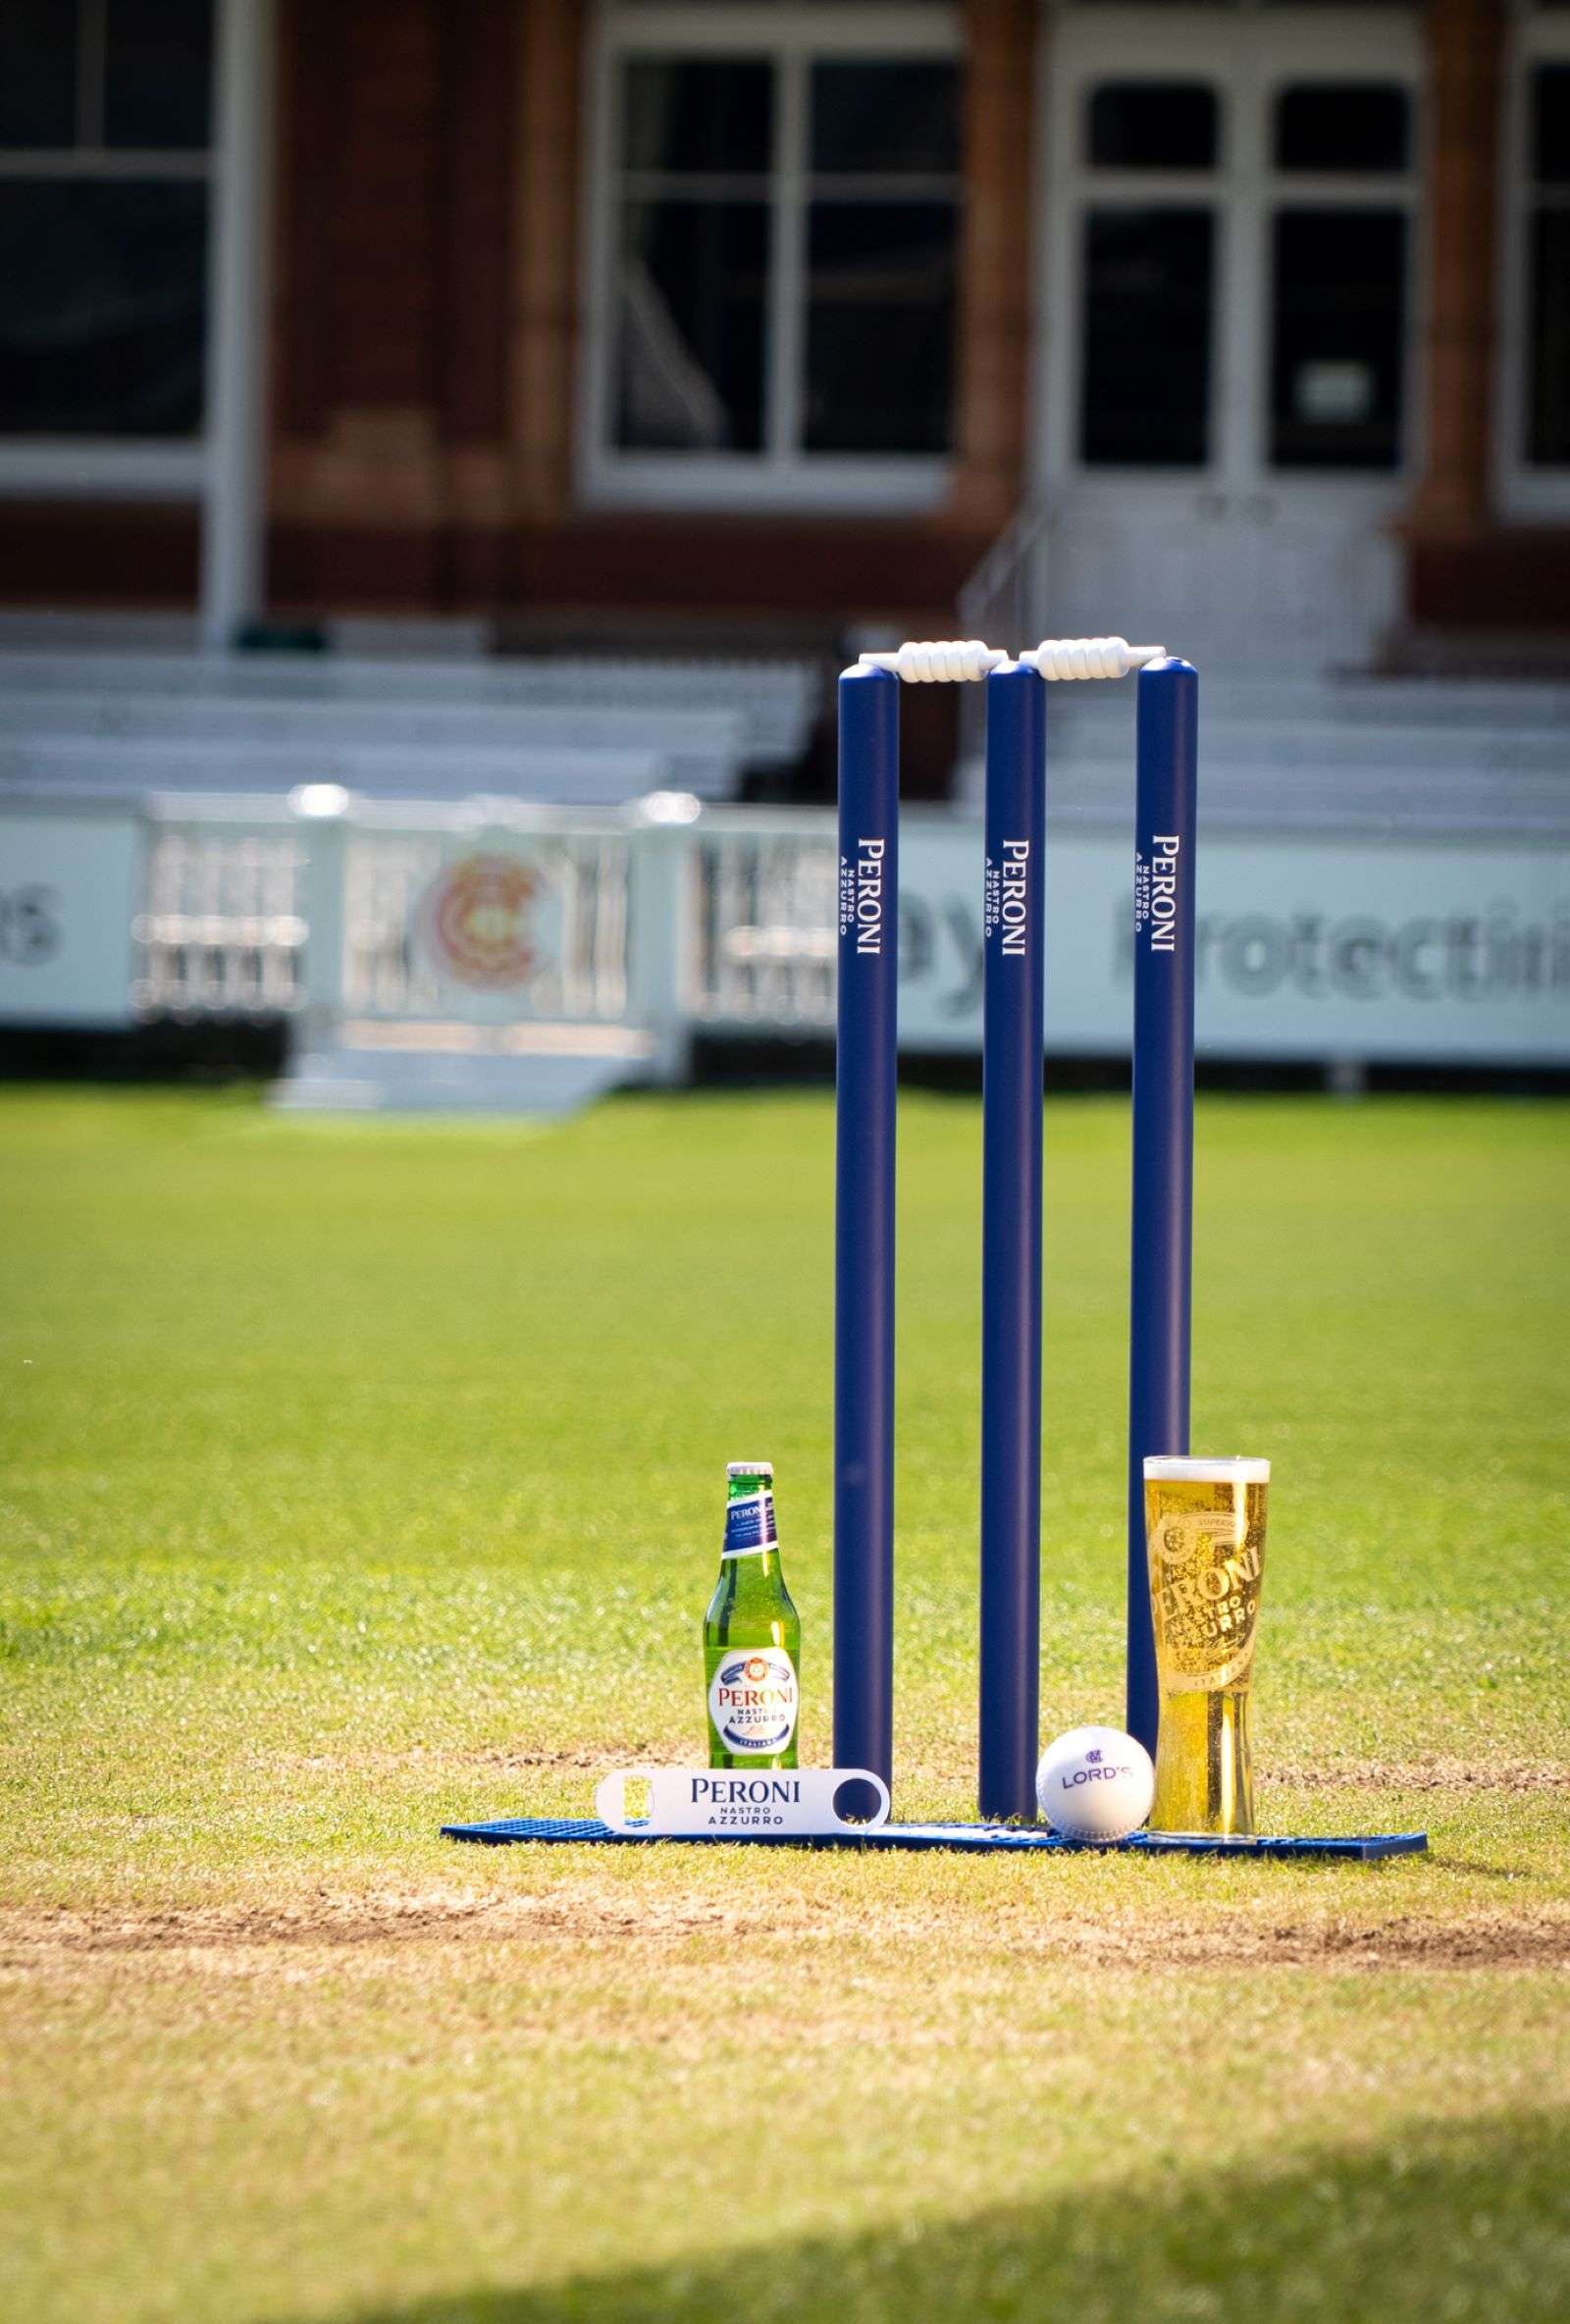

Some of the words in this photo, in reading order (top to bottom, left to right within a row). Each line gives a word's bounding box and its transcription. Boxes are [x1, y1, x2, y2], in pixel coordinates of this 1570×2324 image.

[858, 838, 885, 955] PERONI
[1002, 840, 1029, 956] PERONI
[1151, 835, 1179, 952] PERONI
[730, 1506, 762, 1520] PERON
[718, 1687, 793, 1707] PERONI
[691, 1778, 801, 1803] PERONI
[1062, 1767, 1133, 1790] LORD'S
[707, 1816, 783, 1825] AZZURRO
